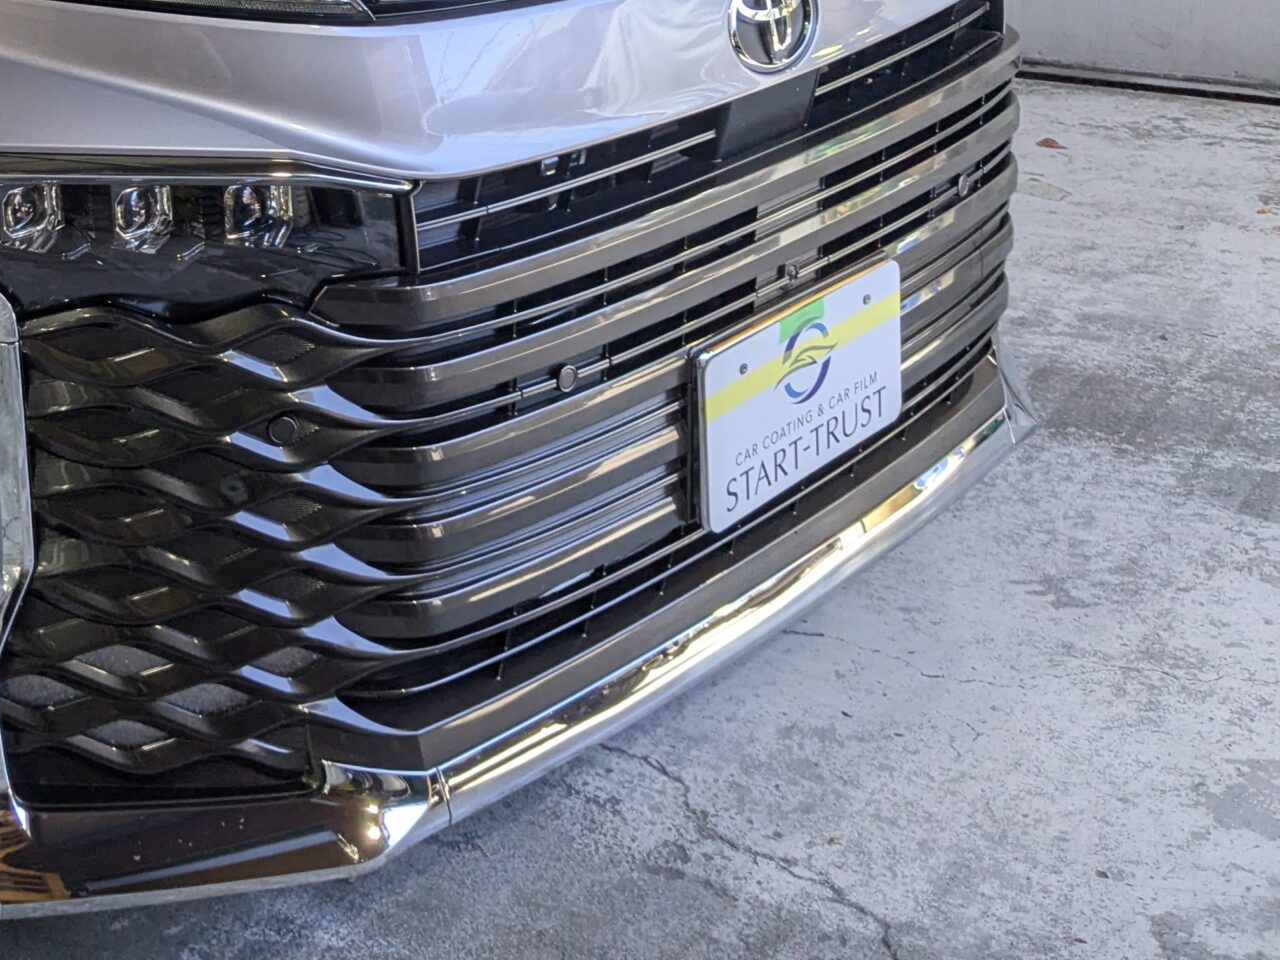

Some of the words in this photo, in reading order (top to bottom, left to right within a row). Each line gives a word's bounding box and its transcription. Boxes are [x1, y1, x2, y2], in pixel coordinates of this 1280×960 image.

[726, 386, 886, 513] START-TRUST
[735, 445, 758, 467] CAR
[762, 406, 813, 448] COATING
[817, 403, 825, 417] &
[828, 388, 850, 409] CAR
[853, 371, 878, 395] FILM
